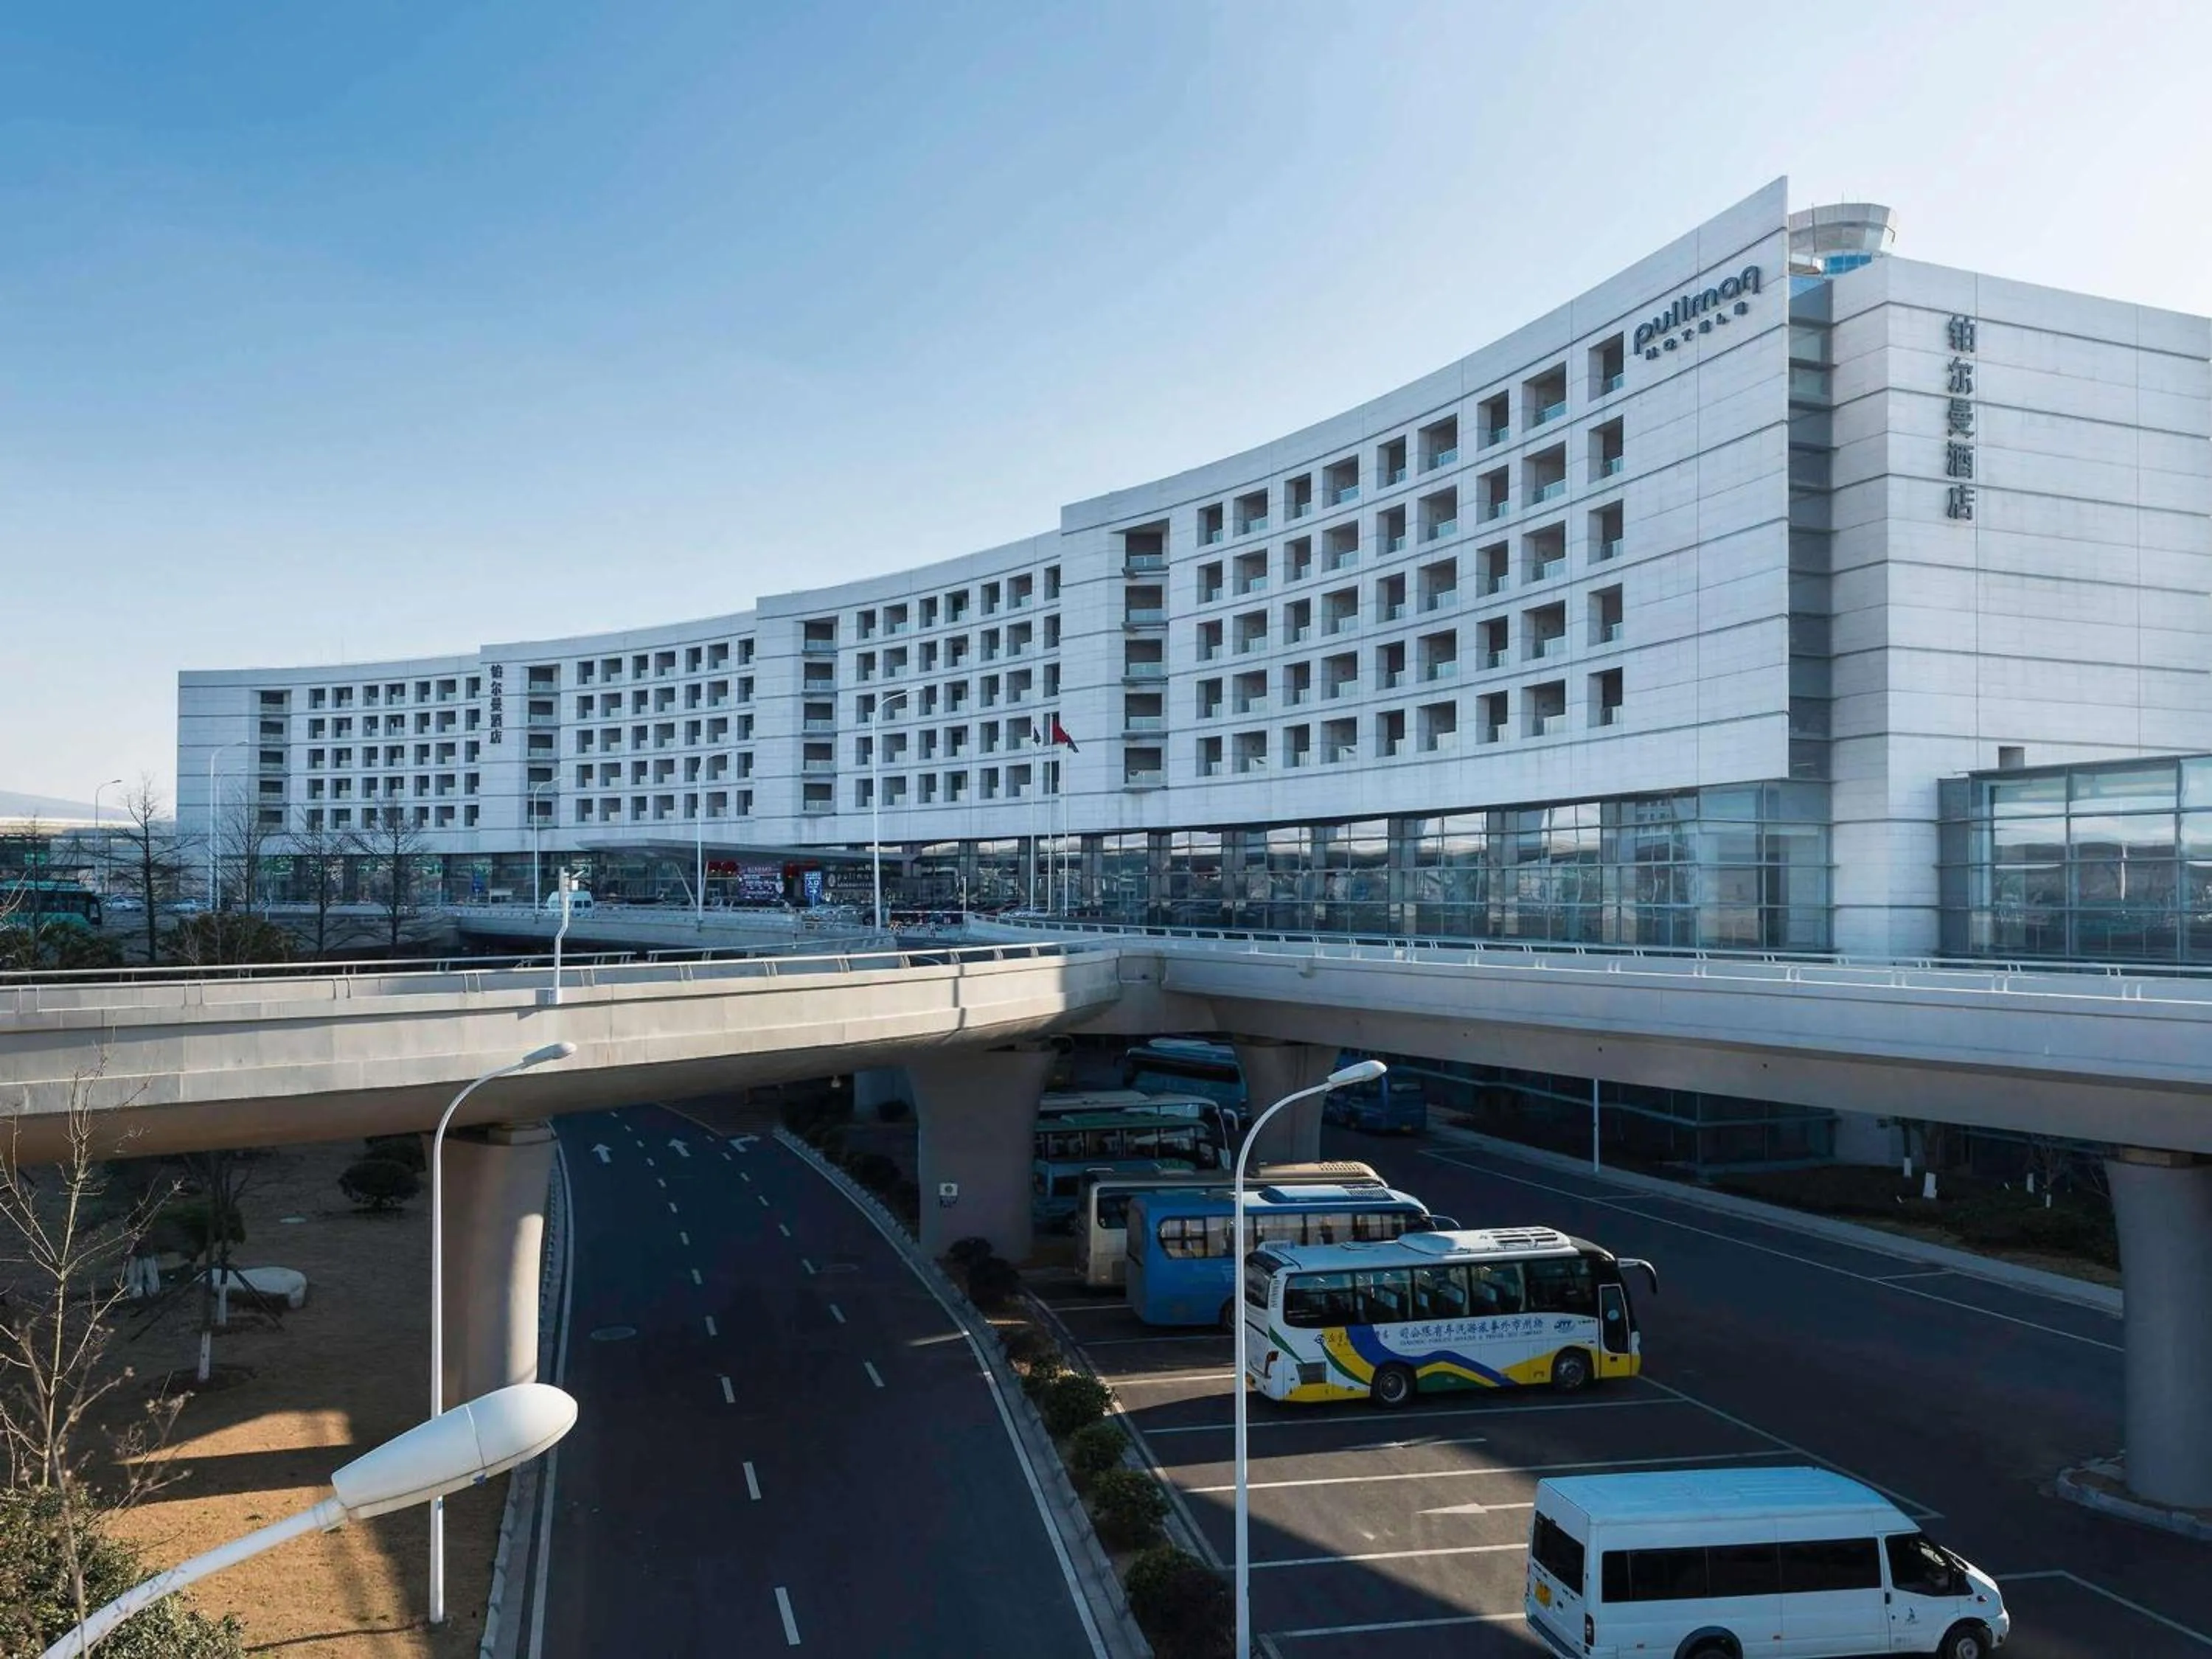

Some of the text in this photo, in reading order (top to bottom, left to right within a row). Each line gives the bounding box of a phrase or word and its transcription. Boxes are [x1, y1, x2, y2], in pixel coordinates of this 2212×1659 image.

[1632, 265, 1761, 355] pullman
[1946, 314, 1975, 521] 铂尔曼酒店
[490, 664, 503, 744] 铂尔曼酒店
